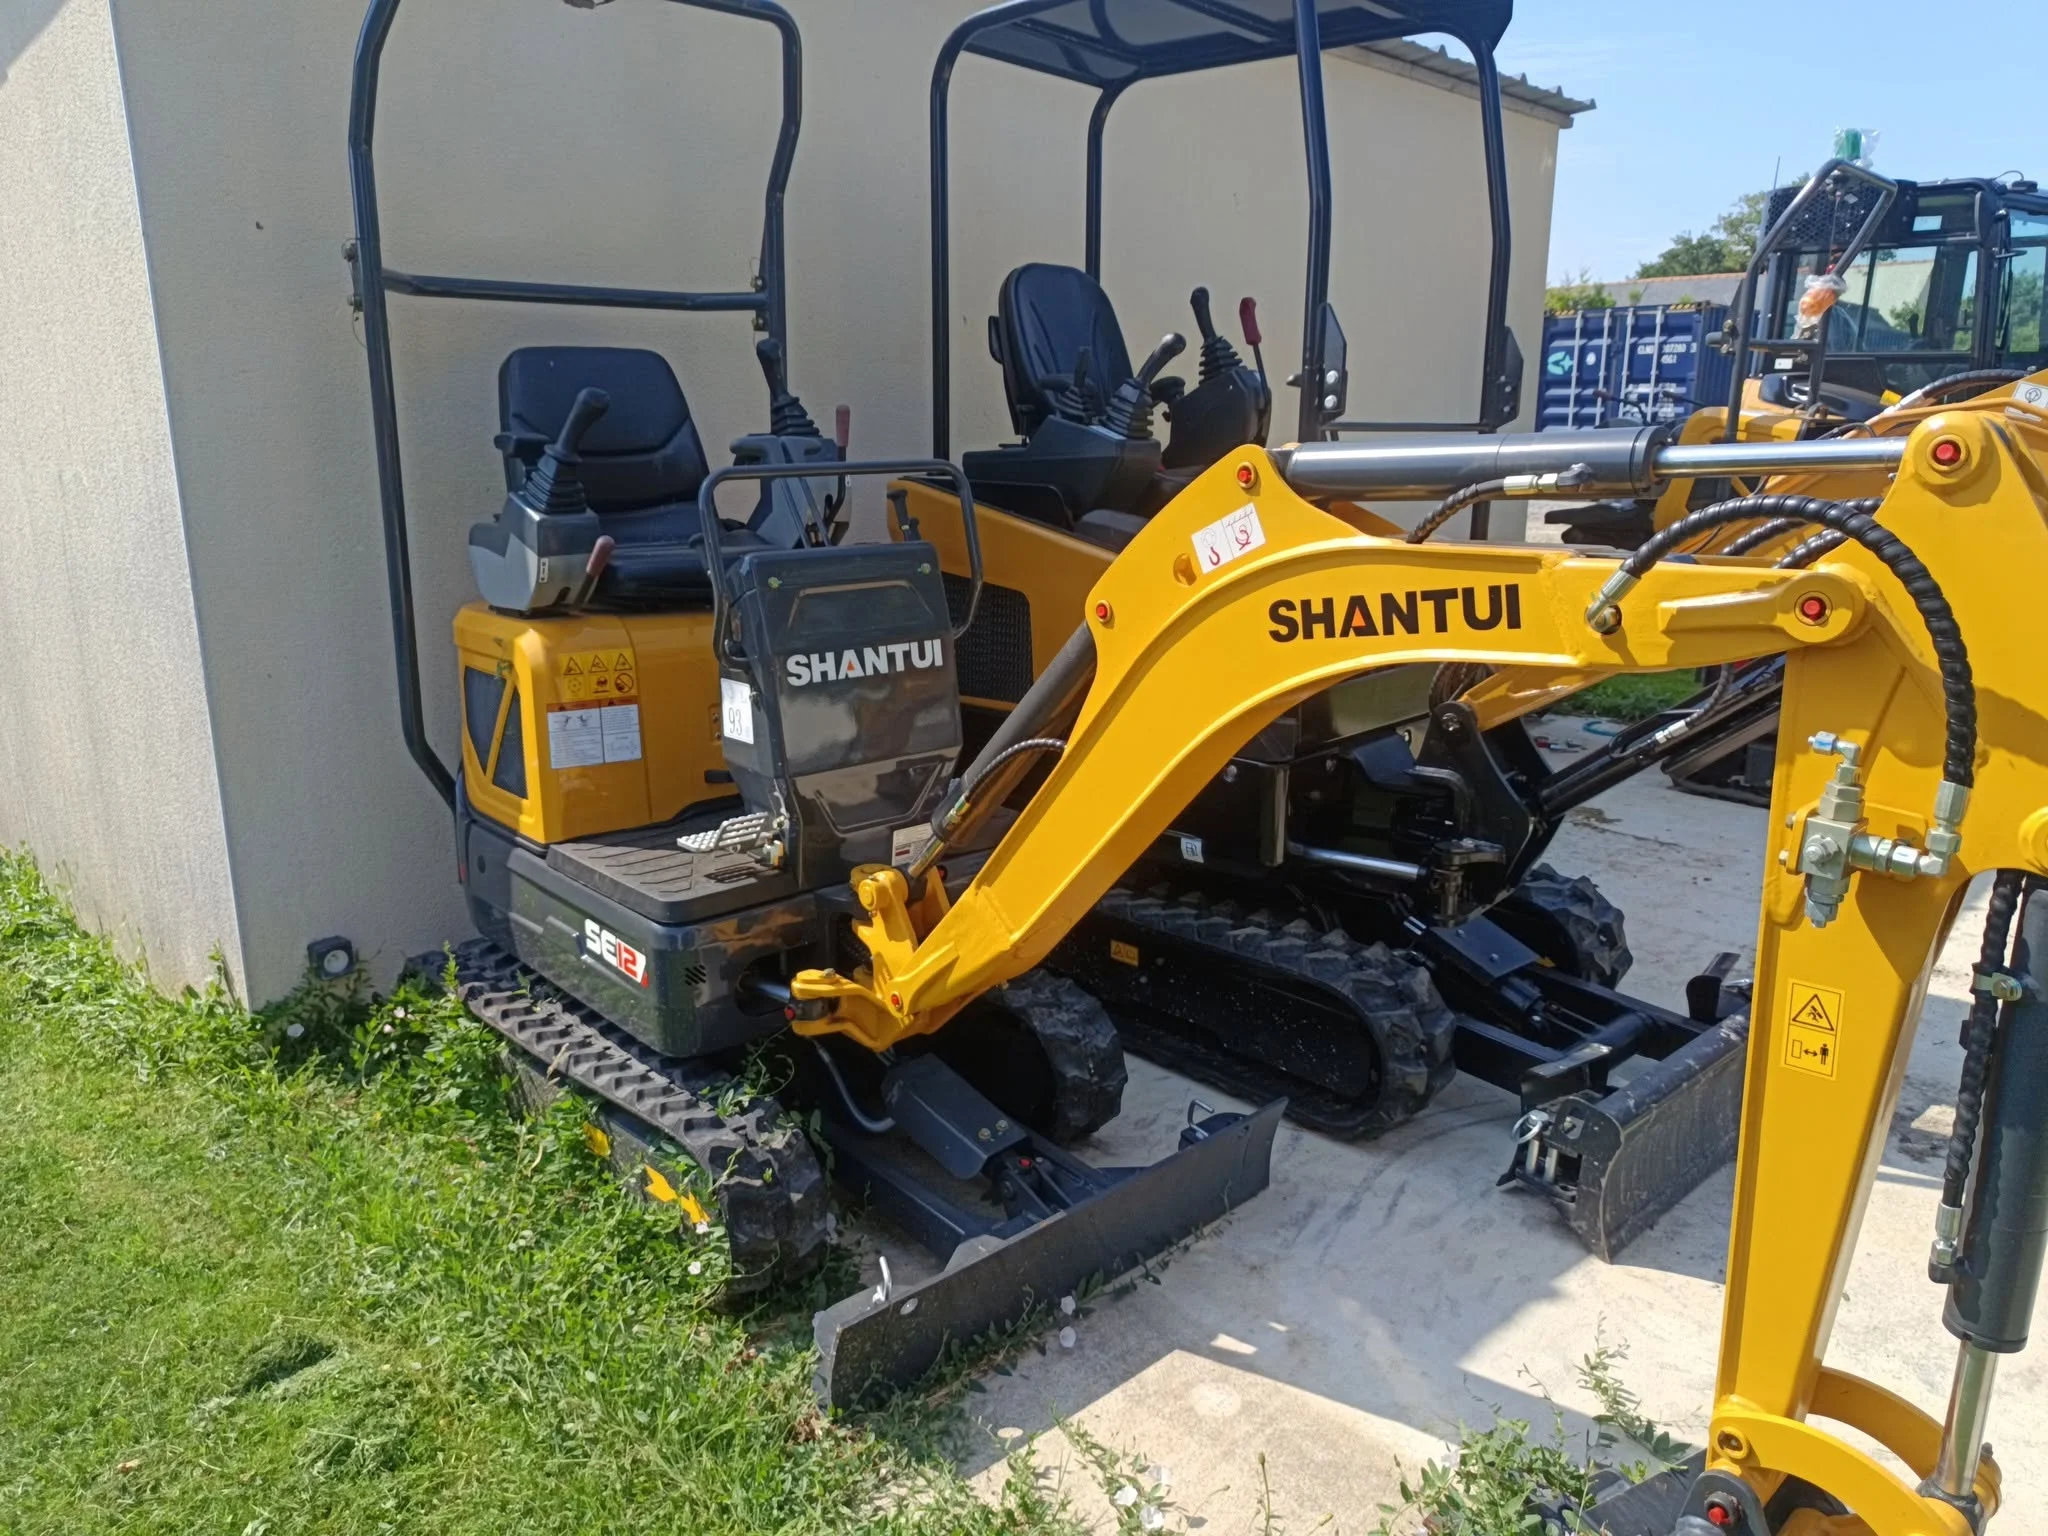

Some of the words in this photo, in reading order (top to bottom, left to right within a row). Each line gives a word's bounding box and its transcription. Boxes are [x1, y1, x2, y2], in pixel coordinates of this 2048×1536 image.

[1268, 583, 1522, 643] SHANTUI
[786, 638, 944, 687] SHANTUI
[728, 707, 743, 736] 93
[584, 918, 643, 983] SE12
